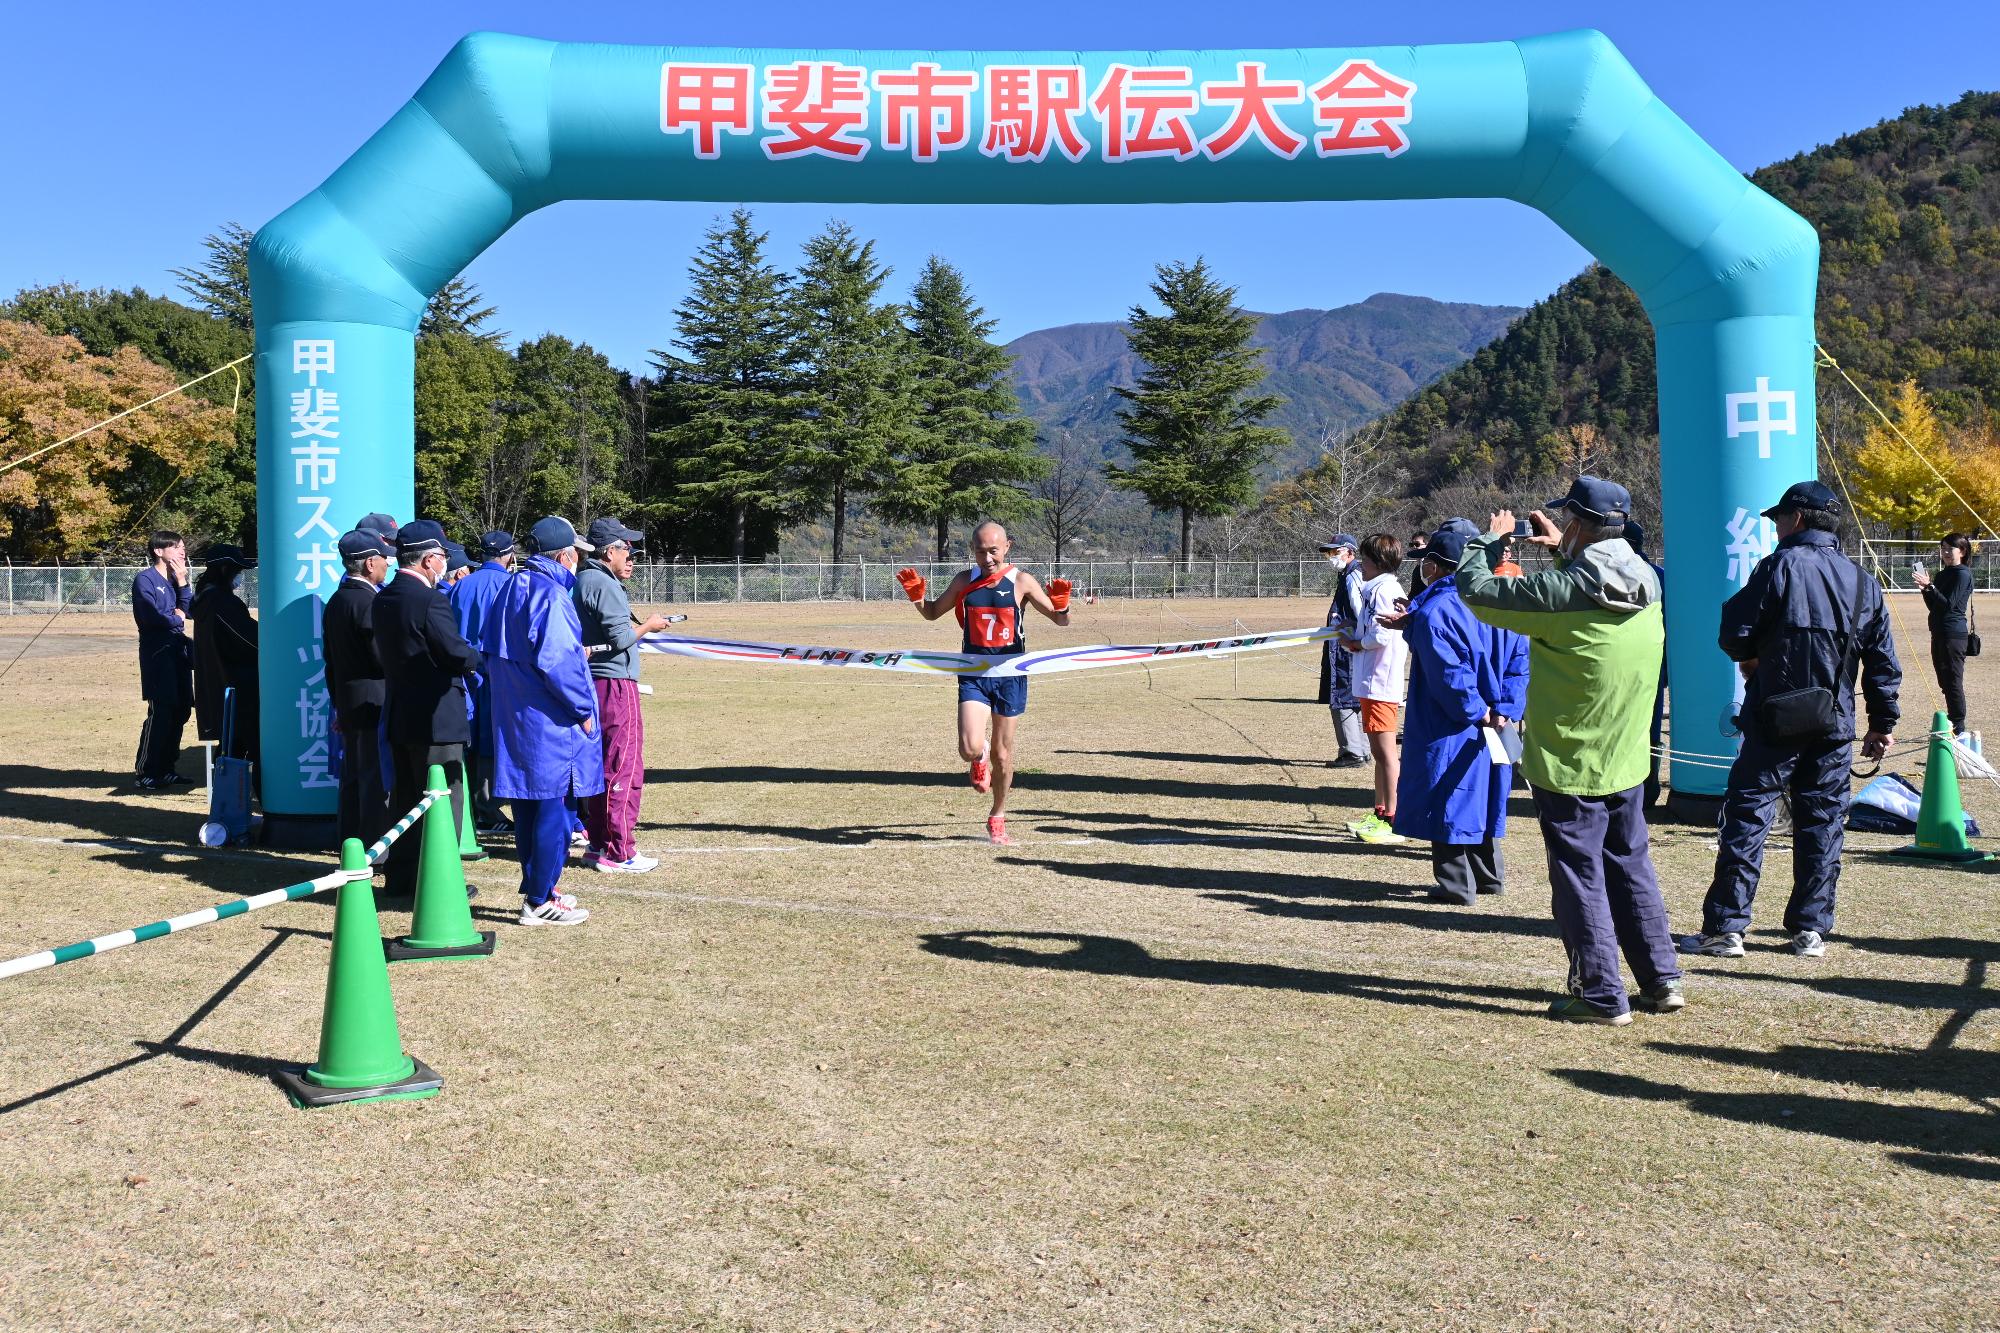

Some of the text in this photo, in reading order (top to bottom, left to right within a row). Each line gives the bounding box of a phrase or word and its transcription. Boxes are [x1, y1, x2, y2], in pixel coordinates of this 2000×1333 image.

[664, 62, 1414, 159] 甲斐市駅伝大会
[290, 339, 340, 788] 甲斐市スポーツ協会
[780, 647, 903, 666] FINISH
